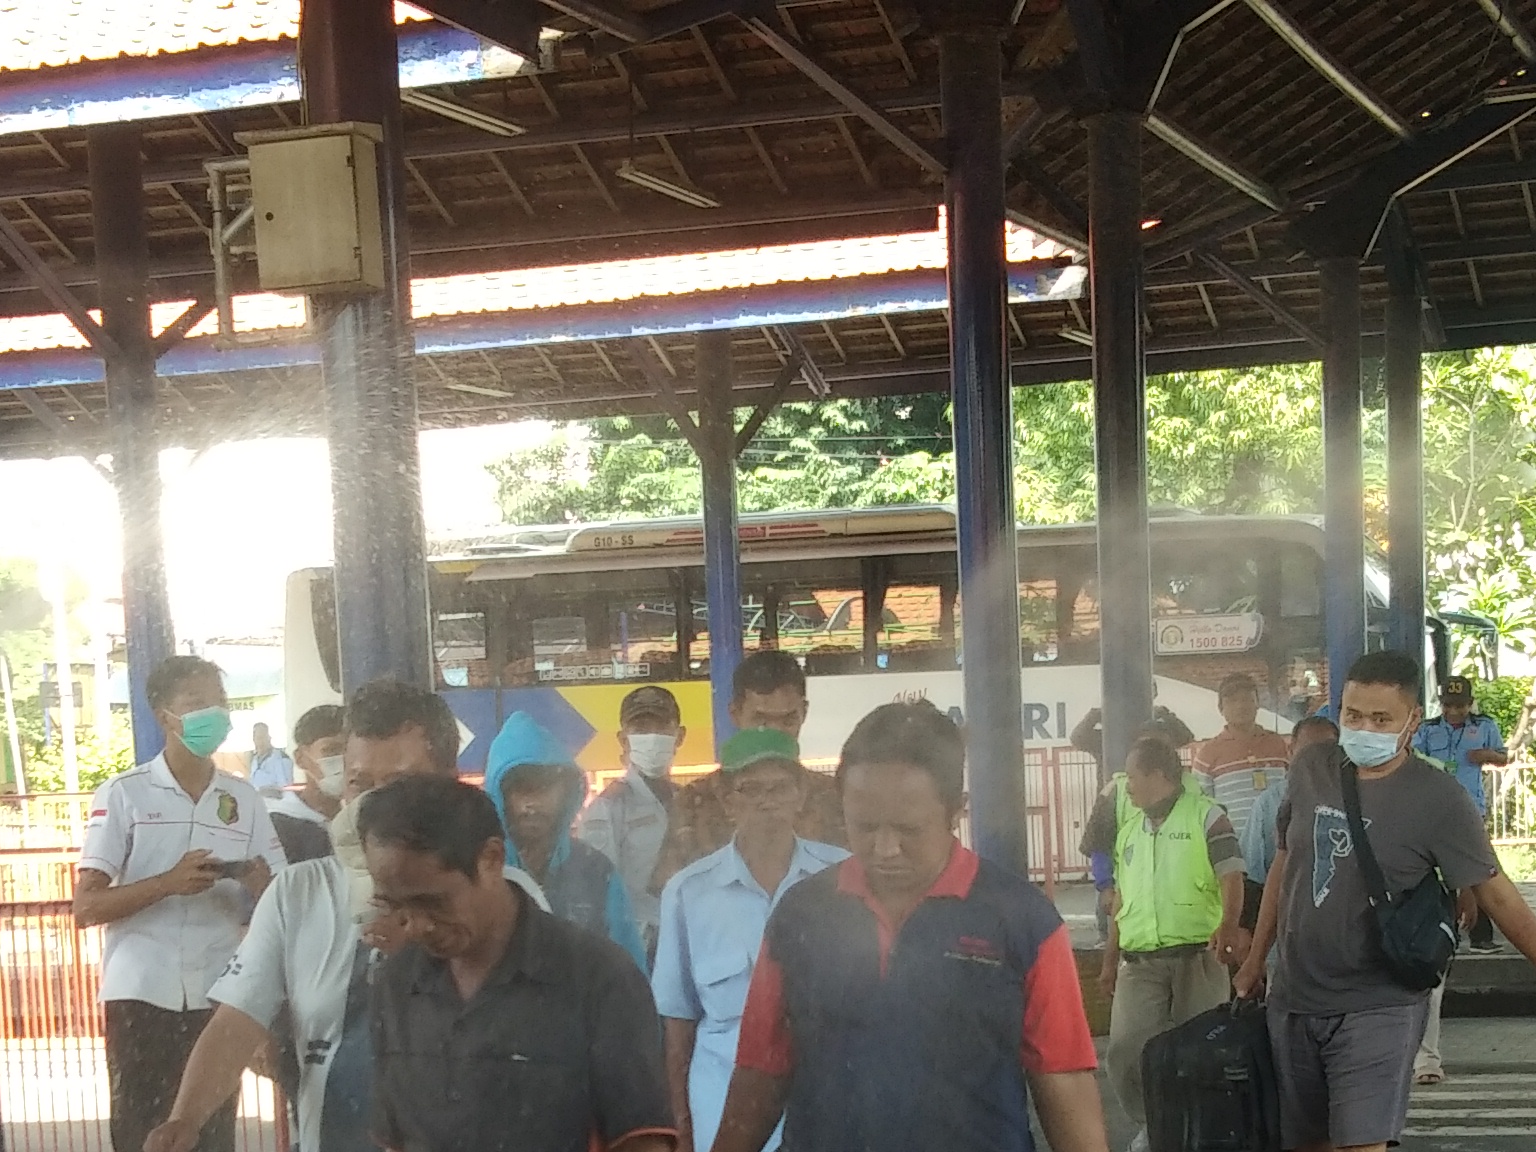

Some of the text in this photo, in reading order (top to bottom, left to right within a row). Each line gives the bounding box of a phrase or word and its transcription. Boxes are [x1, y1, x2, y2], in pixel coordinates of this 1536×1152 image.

[594, 536, 613, 547] G10
[621, 534, 634, 545] SS
[1189, 635, 1243, 649] 1500 825
[1448, 681, 1463, 694] 33
